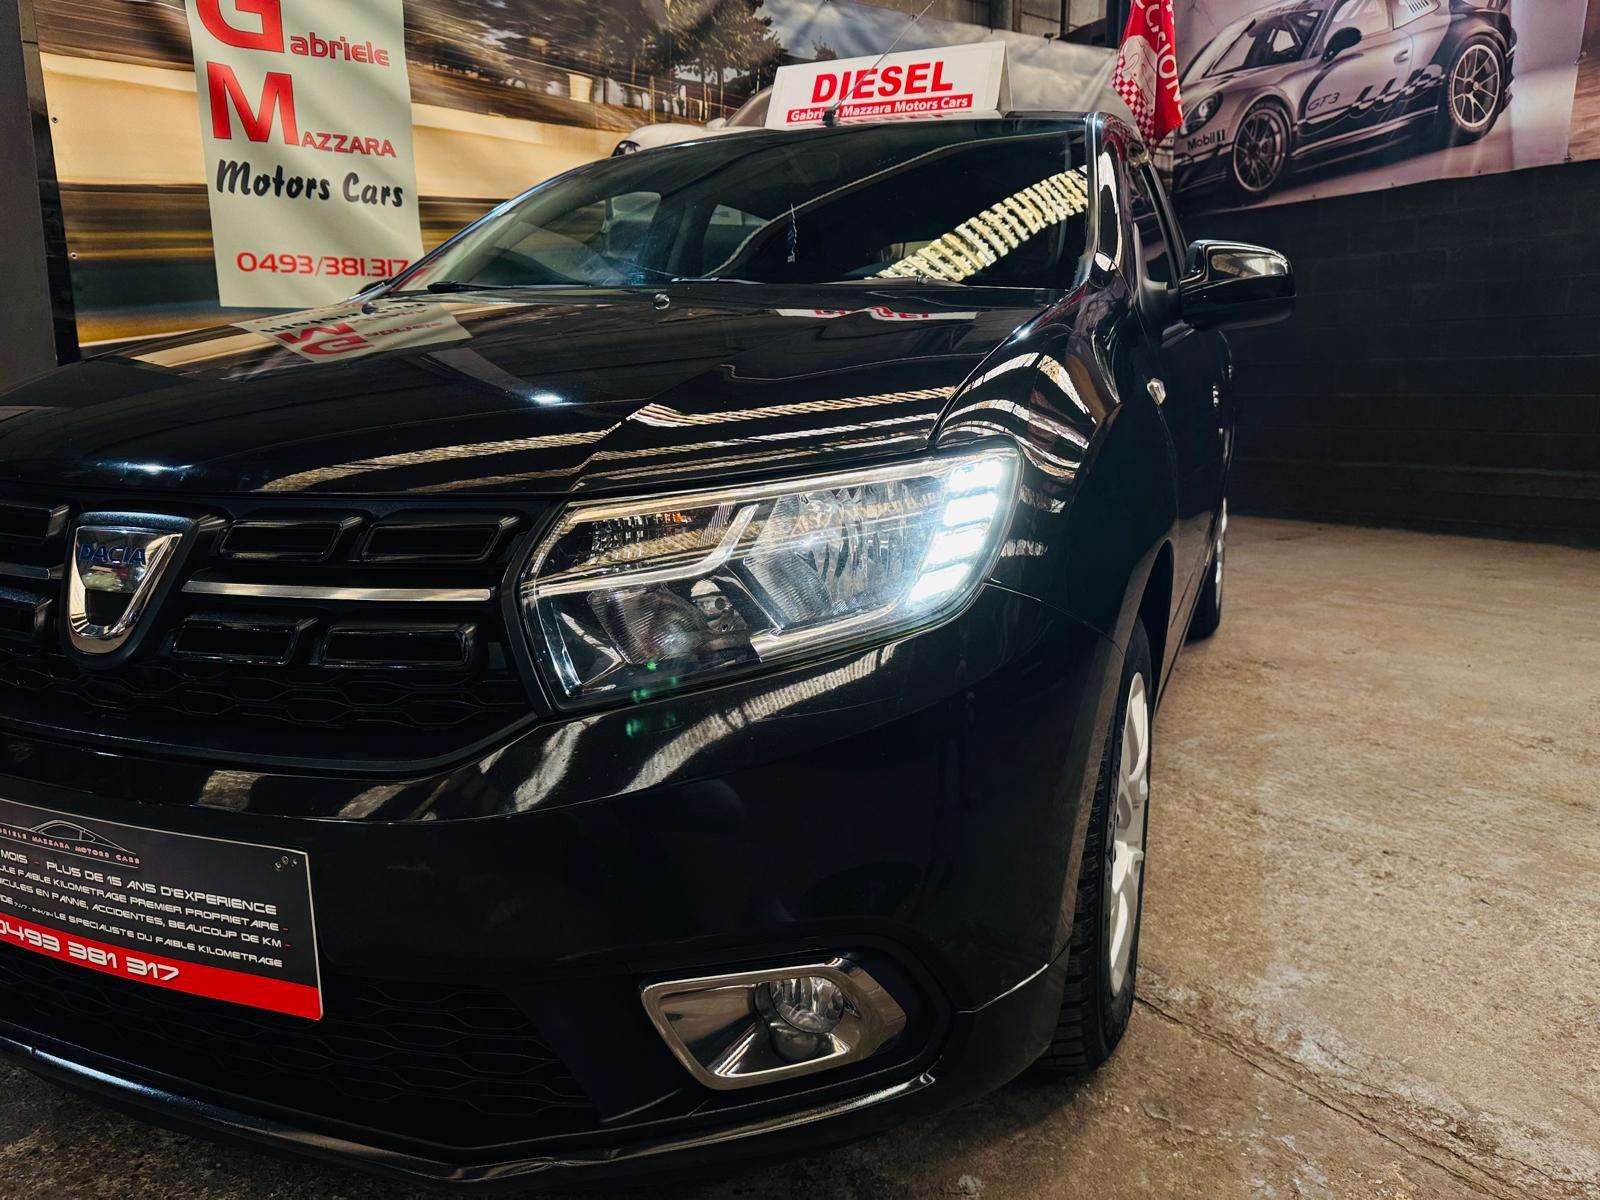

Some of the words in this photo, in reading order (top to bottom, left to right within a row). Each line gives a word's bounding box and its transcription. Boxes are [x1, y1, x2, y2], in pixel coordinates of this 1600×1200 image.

[811, 61, 953, 104] DIESEL
[1307, 92, 1340, 112] GT3
[206, 61, 397, 157] MAZZARA
[842, 103, 890, 118] Mazzara
[894, 100, 938, 113] Motors
[940, 96, 968, 109] Cars
[216, 158, 331, 201] Motors
[342, 172, 404, 208] Cars
[236, 252, 410, 278] 0493/381.317
[78, 543, 147, 567] DACIA
[75, 845, 110, 858] MOTORS
[0, 849, 28, 864] MOIS
[46, 861, 81, 878] PLUS
[84, 870, 104, 883] DE
[107, 875, 122, 887] 15
[127, 880, 157, 894] ANS
[160, 885, 277, 915] D'EXPERIENCE
[18, 869, 51, 884] FAIBLE
[53, 878, 127, 903] KILOMETRAGE
[130, 897, 182, 914] PREMIER
[185, 907, 280, 932] PROPRIETAIRE
[35, 888, 50, 899] EN
[92, 903, 166, 928] ACCIDENTES,
[168, 919, 238, 938] BEAUCOUP
[241, 933, 259, 944] DE
[262, 936, 282, 948] KM
[54, 911, 66, 921] LE
[68, 915, 135, 939] SPECIALISTE
[137, 932, 153, 942] DU
[155, 936, 196, 951] FAIBLE
[198, 944, 283, 968] KILOMETRAGE
[67, 940, 118, 969] 381
[126, 955, 179, 981] 317
